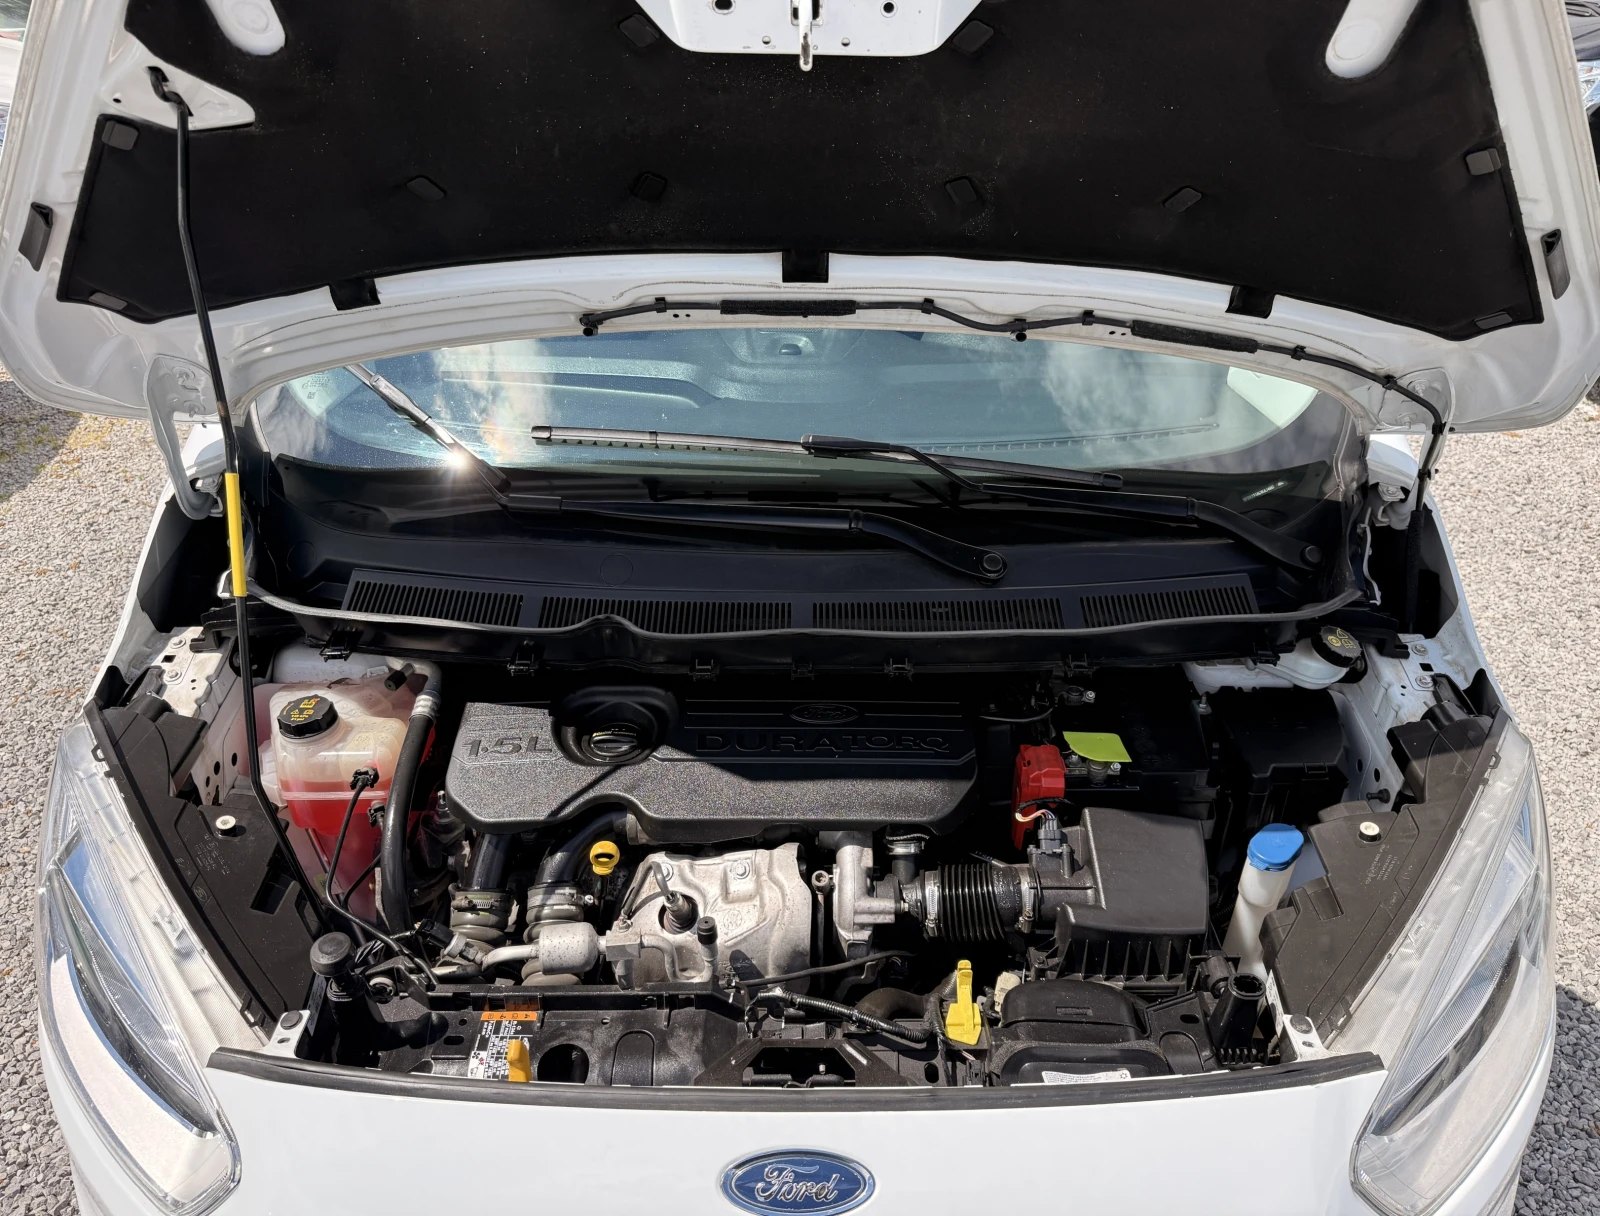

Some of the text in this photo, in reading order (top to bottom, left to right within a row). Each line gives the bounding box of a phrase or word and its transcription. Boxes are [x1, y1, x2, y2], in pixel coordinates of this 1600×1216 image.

[803, 704, 848, 720] Ford
[462, 736, 553, 757] 1.5L
[696, 731, 950, 753] DURATORQ
[755, 1163, 840, 1202] Ford
